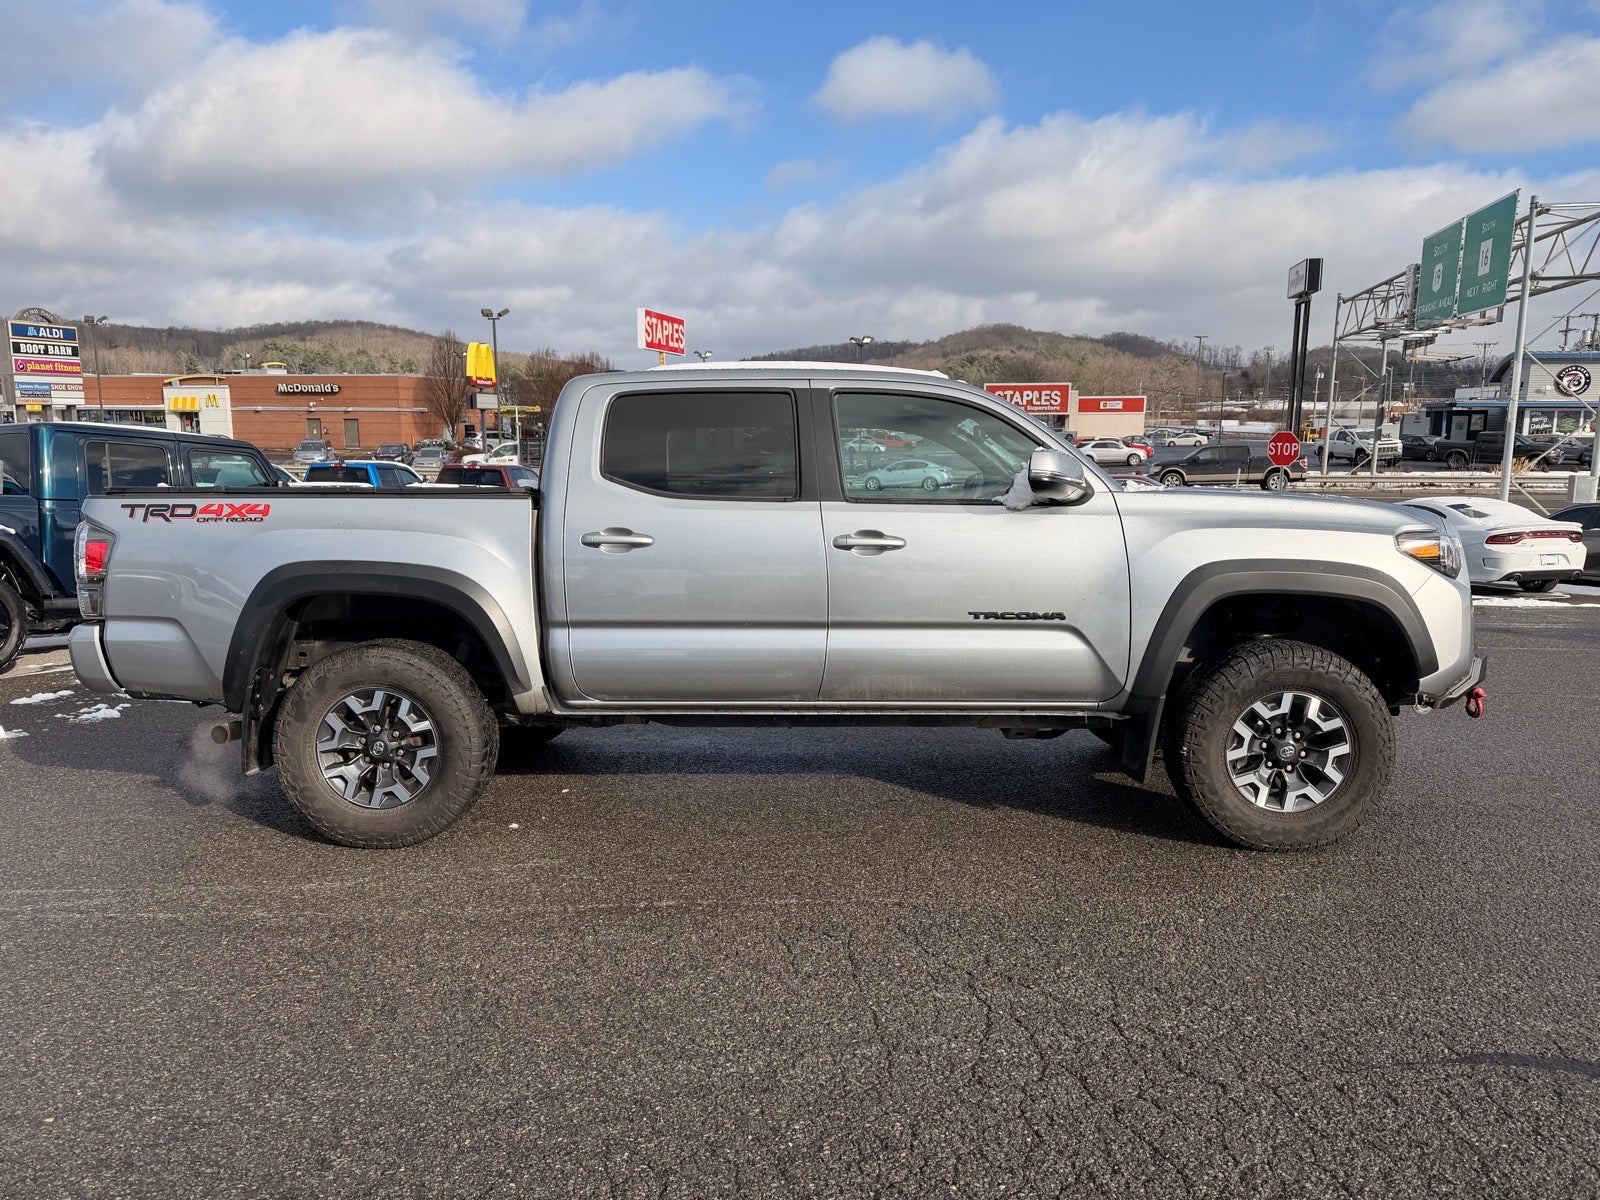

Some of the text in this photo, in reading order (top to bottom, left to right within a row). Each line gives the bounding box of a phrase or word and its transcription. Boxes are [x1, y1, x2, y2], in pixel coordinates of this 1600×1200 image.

[1482, 220, 1496, 233] SOUTH
[1434, 244, 1448, 256] SOUTH
[1481, 248, 1489, 267] 16
[1433, 268, 1441, 284] 19
[1466, 280, 1497, 297] NEXT RIGHT
[1418, 296, 1453, 315] STRAIGHT AHEAD
[39, 327, 63, 339] ALDI
[645, 316, 685, 350] STAPLES
[20, 343, 73, 356] BOOT BARN
[26, 361, 81, 372] planet fitness
[277, 383, 339, 393] McDonald's
[206, 393, 220, 408] M
[1269, 443, 1298, 455] STOP
[121, 503, 198, 523] TRD
[967, 611, 1067, 621] TACOMA
